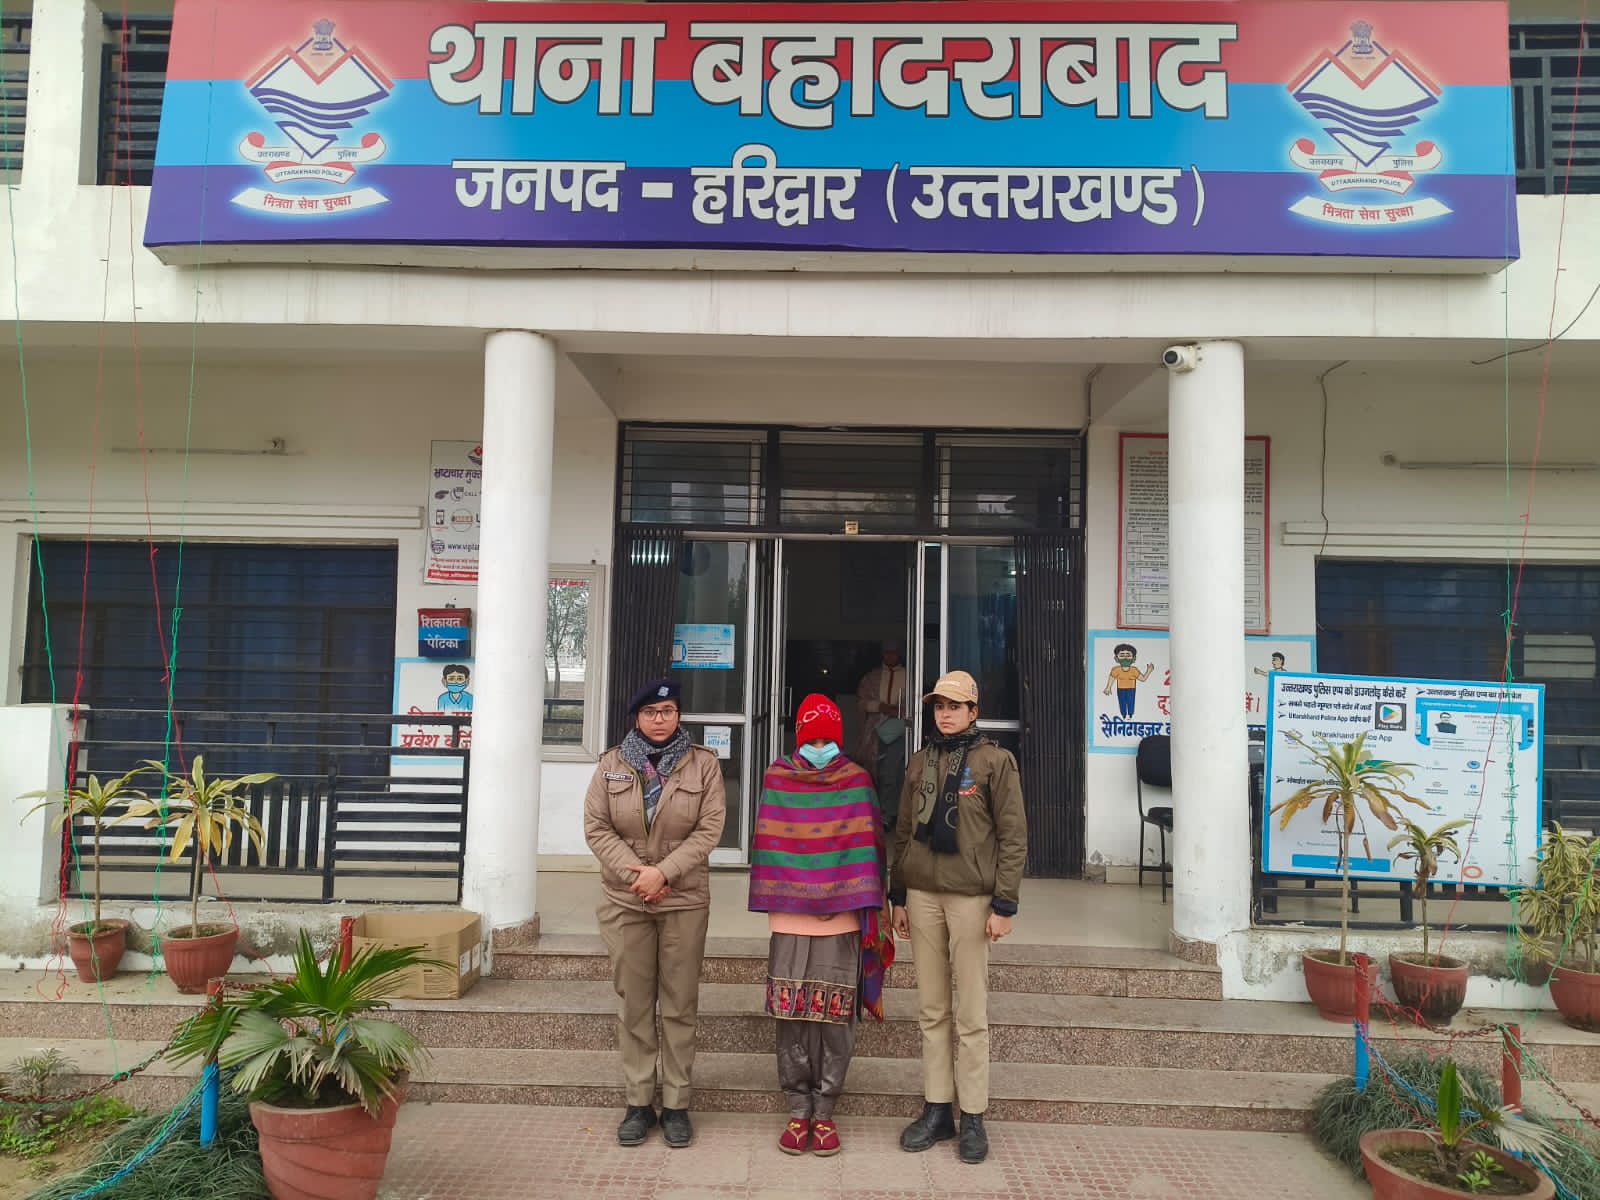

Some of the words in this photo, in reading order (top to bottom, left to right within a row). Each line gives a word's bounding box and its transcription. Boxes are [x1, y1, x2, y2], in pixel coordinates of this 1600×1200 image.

[427, 21, 667, 115] थाना
[688, 21, 1238, 129] बहादराबाद
[450, 158, 627, 214] जनपद
[689, 143, 863, 227] हरिद्वार
[298, 196, 319, 210] सेवा
[322, 194, 353, 212] सुरक्षा
[1359, 206, 1381, 221] सेवा
[1385, 205, 1415, 223] सुरक्षा
[421, 615, 462, 629] शिकायत
[424, 634, 463, 649] पेटिका
[1314, 682, 1331, 698] पुलिस
[1344, 684, 1353, 696] को
[1100, 714, 1164, 738] सैनिटाइजर
[400, 729, 440, 748] प्रवेश
[1311, 729, 1355, 739] Uttarakhand
[1379, 733, 1393, 743] App
